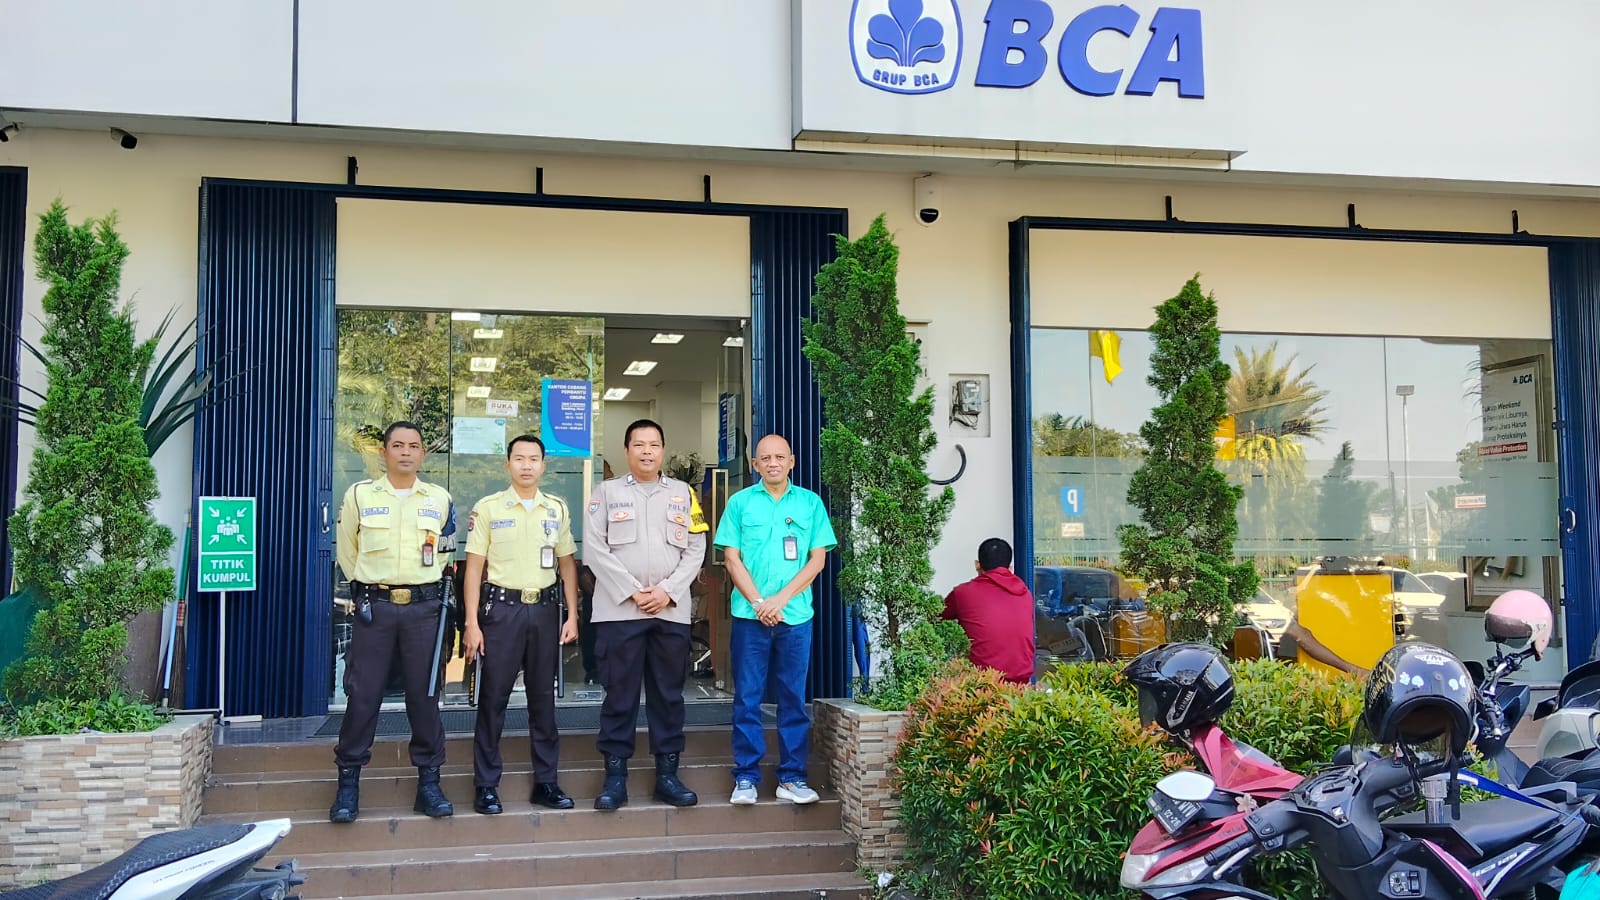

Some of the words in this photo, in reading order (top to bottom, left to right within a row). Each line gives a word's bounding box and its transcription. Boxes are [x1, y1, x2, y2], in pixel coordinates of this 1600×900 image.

[975, 0, 1205, 99] BCA
[872, 69, 906, 86] GRUP
[914, 73, 939, 86] BCA
[1519, 374, 1533, 384] BCA
[210, 559, 244, 569] TITIK
[203, 572, 251, 583] KUMPUL
